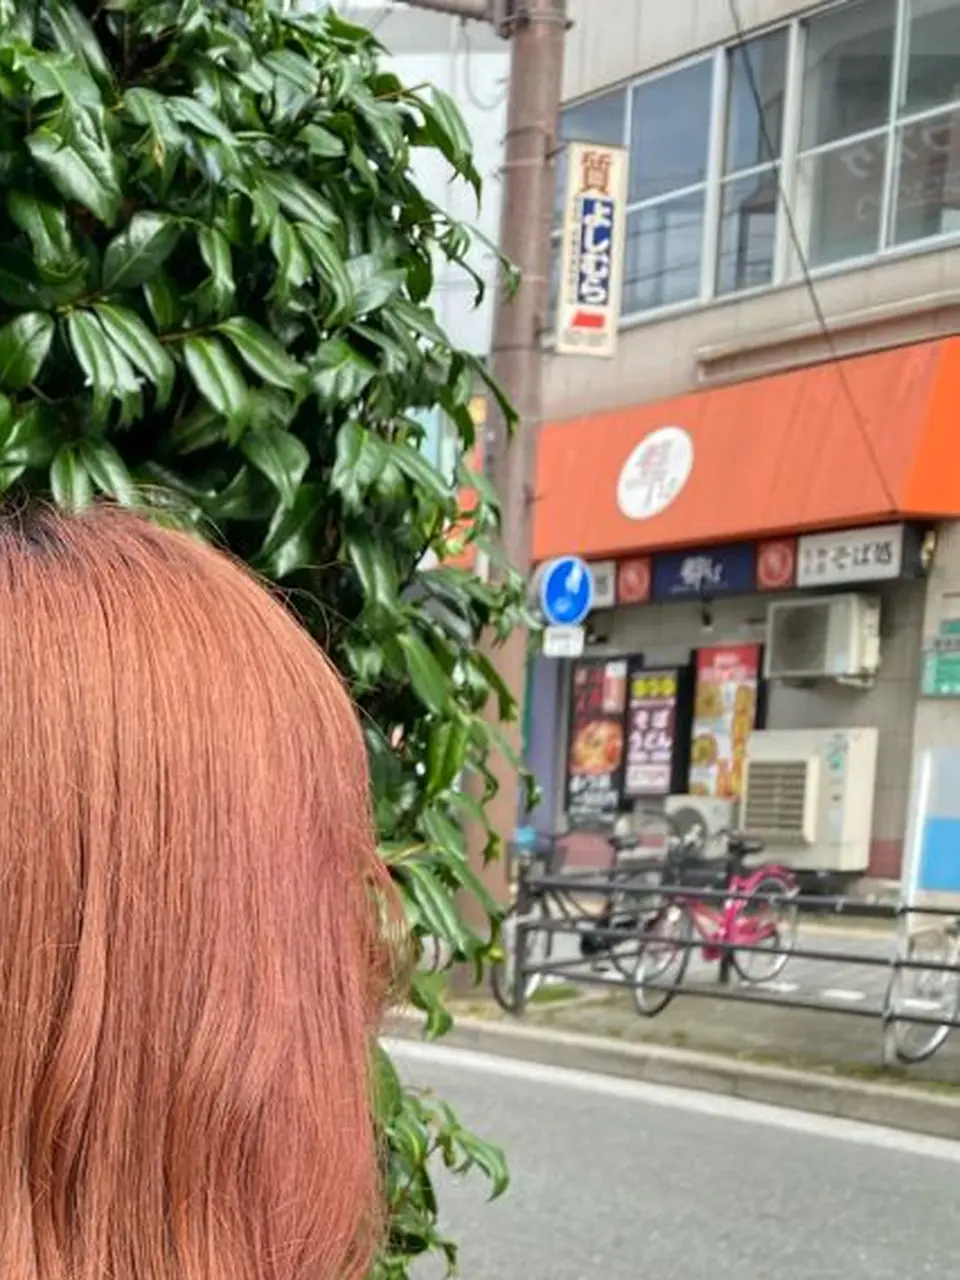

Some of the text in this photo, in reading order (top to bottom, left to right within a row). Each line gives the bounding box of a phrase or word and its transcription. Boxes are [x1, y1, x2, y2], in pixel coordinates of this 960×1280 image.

[581, 151, 611, 195] 質
[578, 200, 613, 304] よしむら
